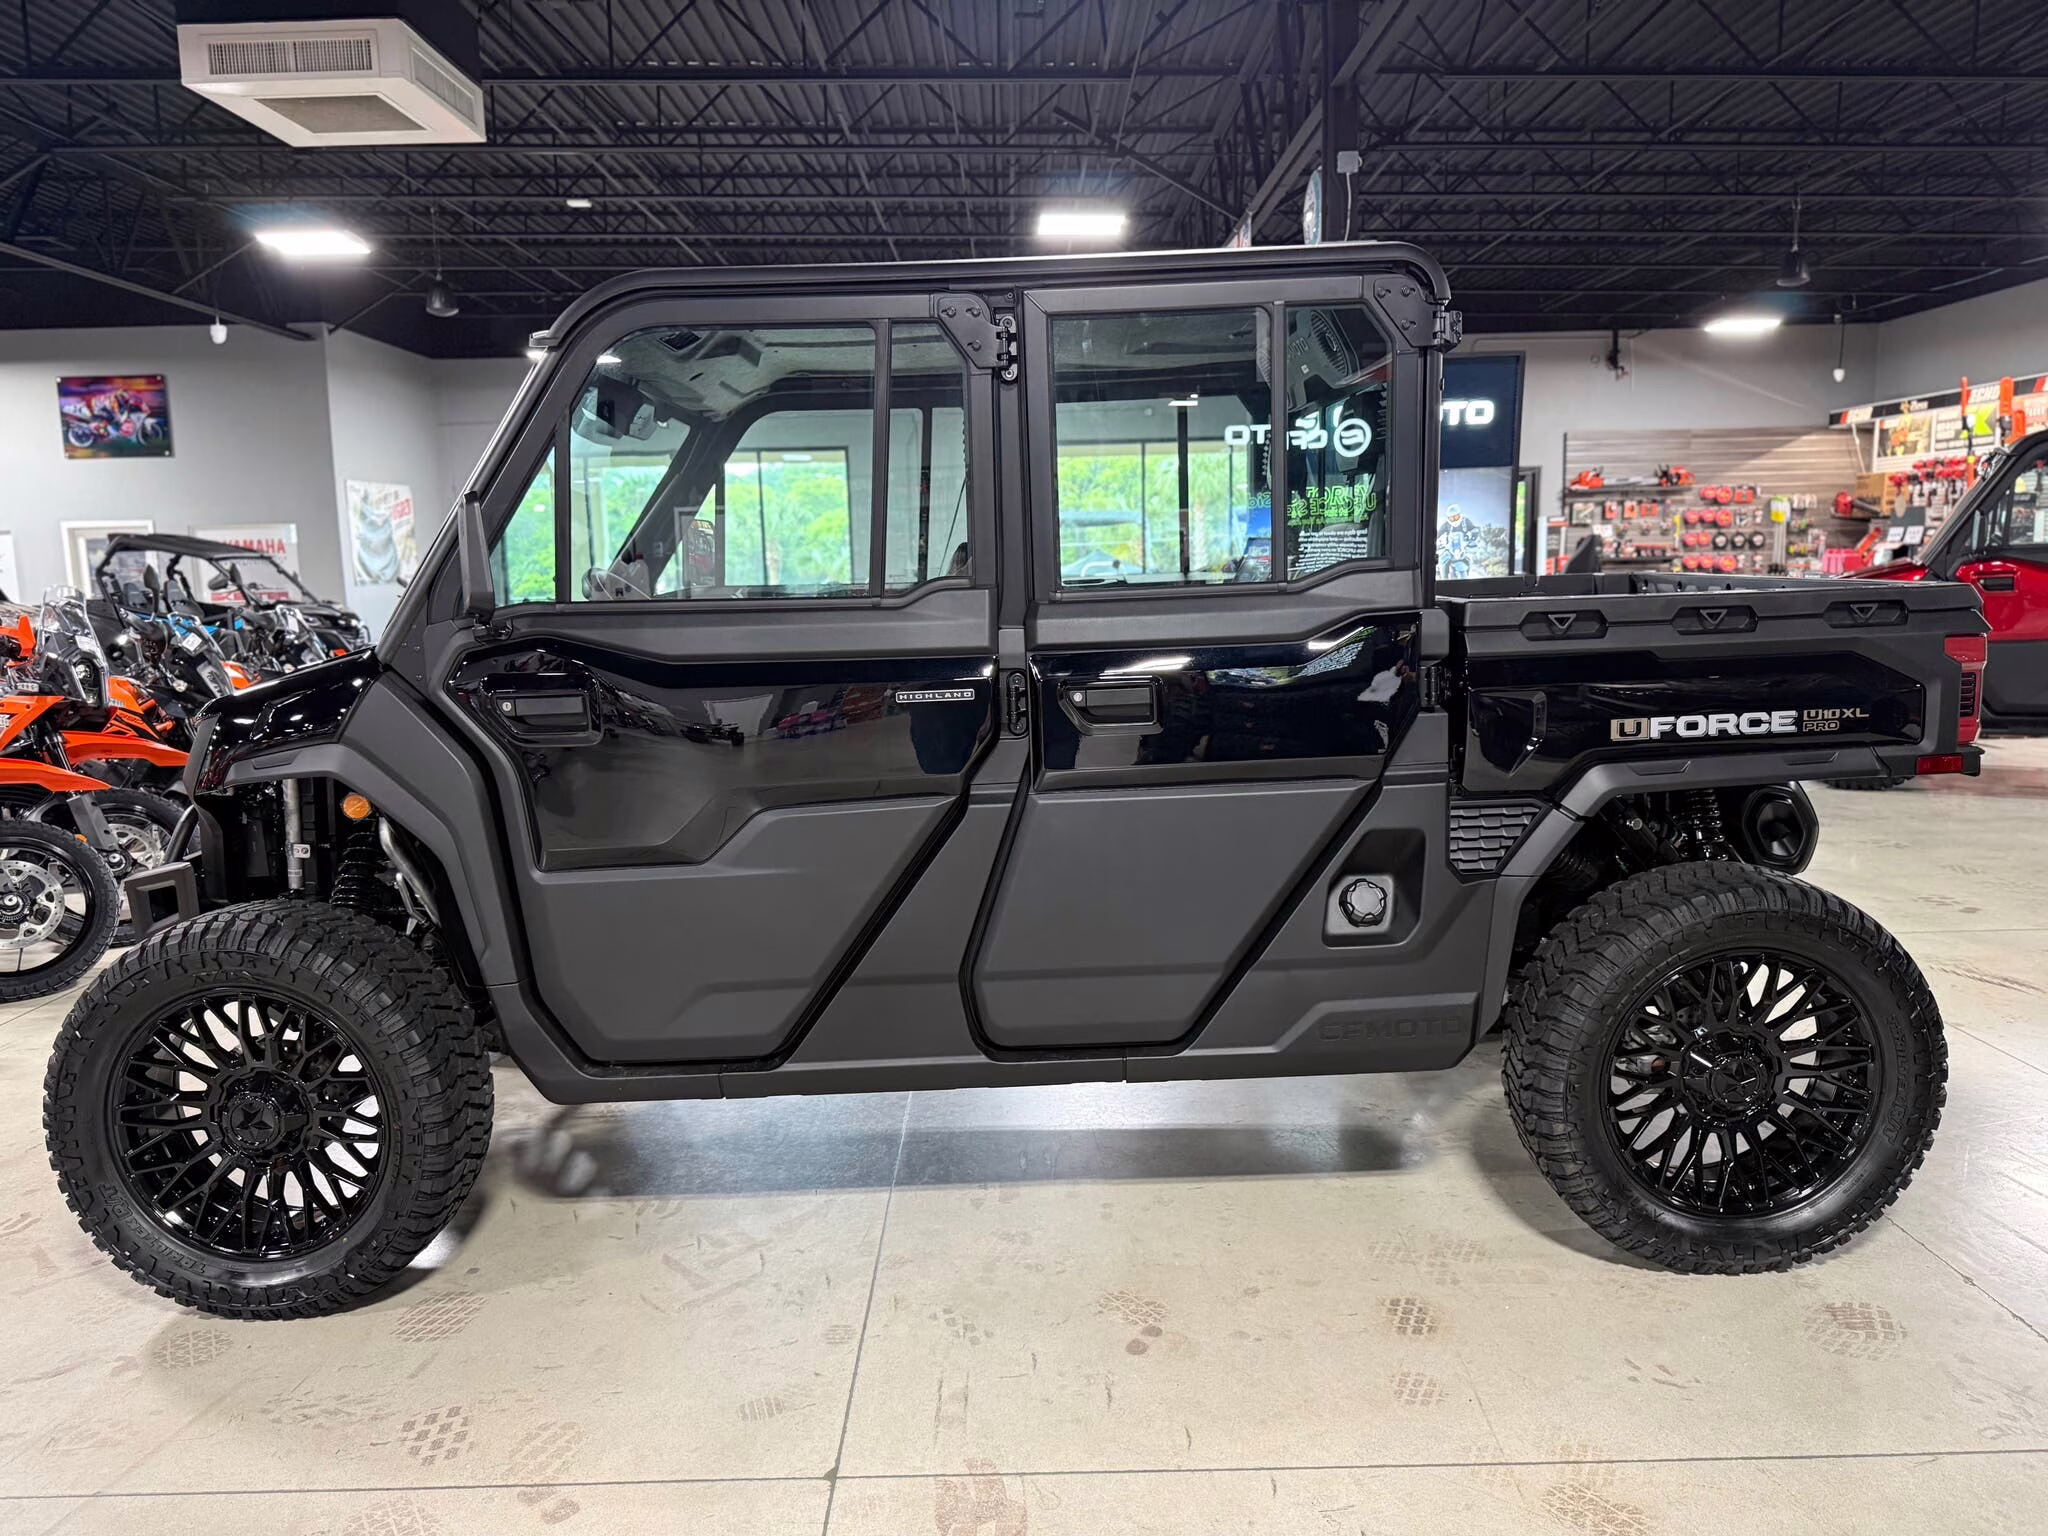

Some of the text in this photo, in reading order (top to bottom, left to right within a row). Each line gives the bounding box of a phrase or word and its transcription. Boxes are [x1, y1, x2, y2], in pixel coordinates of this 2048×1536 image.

[1440, 400, 1494, 425] TO
[899, 691, 972, 700] HIGHLAND
[1803, 720, 1840, 732] PRO
